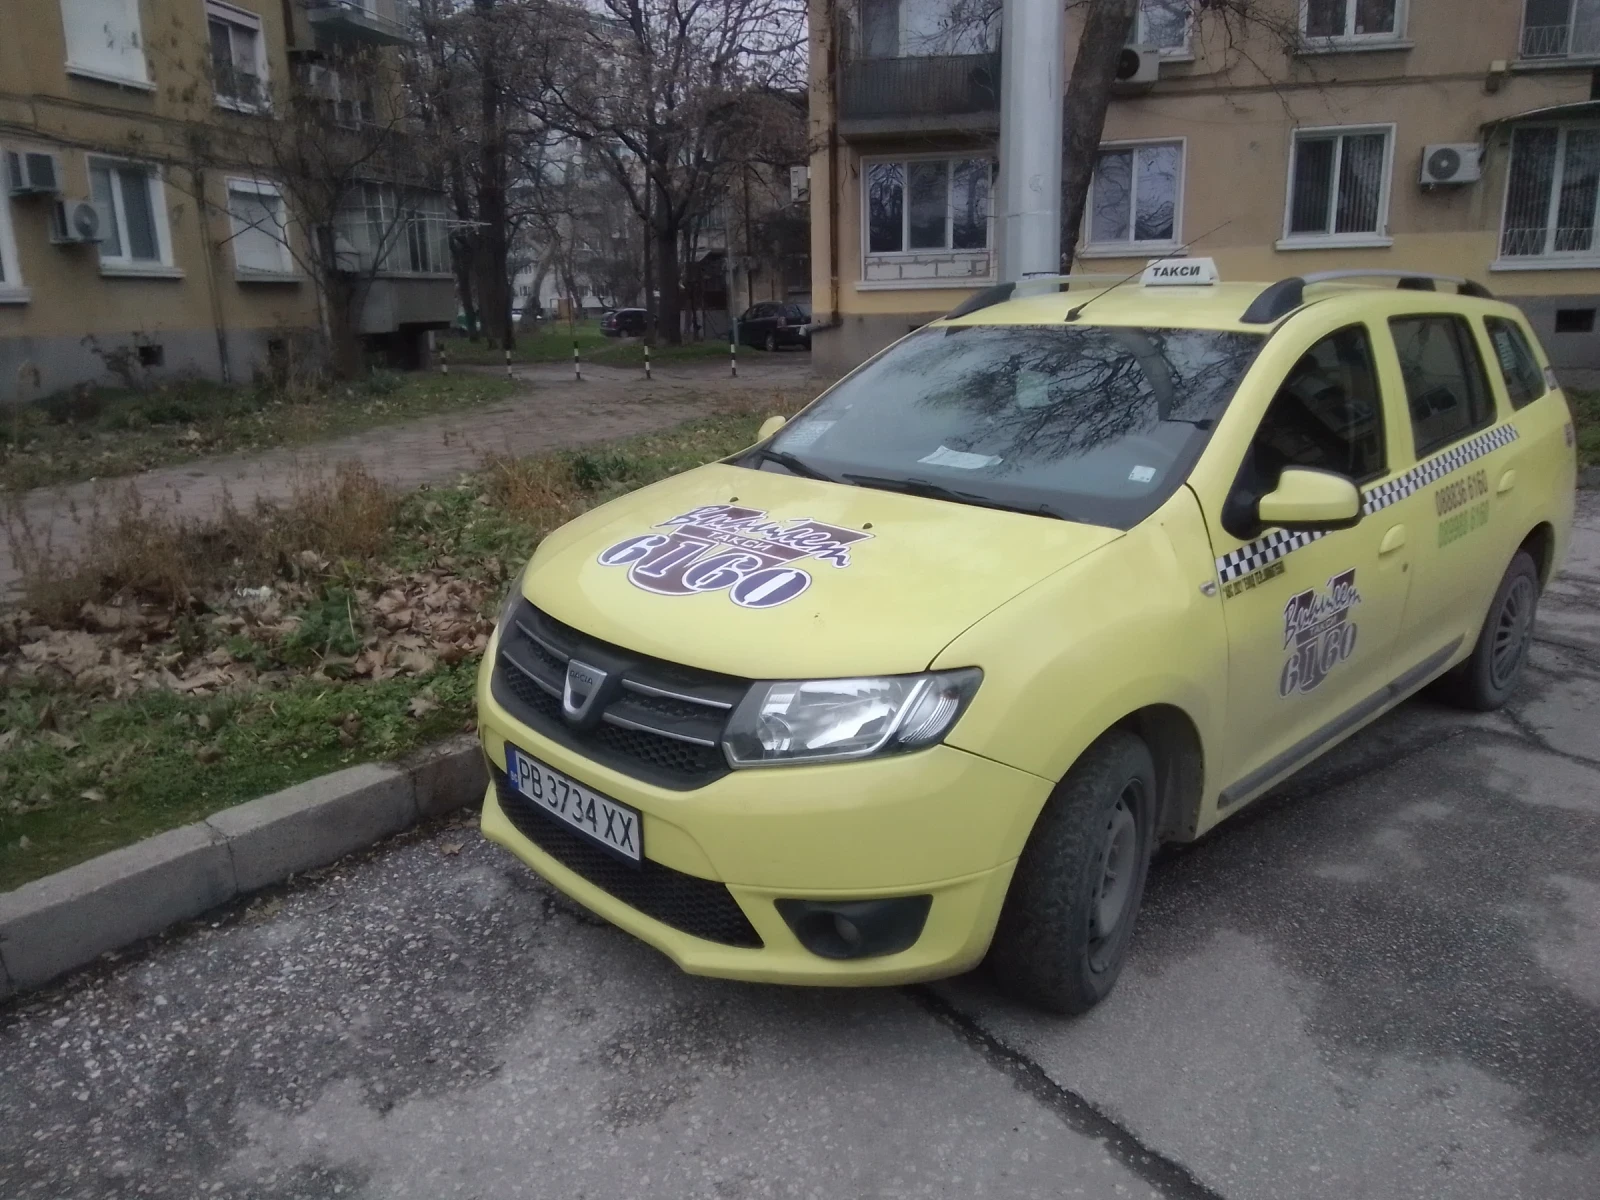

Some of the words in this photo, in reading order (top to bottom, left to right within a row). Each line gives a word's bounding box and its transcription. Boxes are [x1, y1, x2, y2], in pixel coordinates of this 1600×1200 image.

[1153, 266, 1201, 277] ТАКСИ
[706, 531, 773, 551] ТАКСИ
[597, 534, 812, 609] 6160
[1279, 622, 1358, 699] 6160
[569, 670, 594, 686] DACIA
